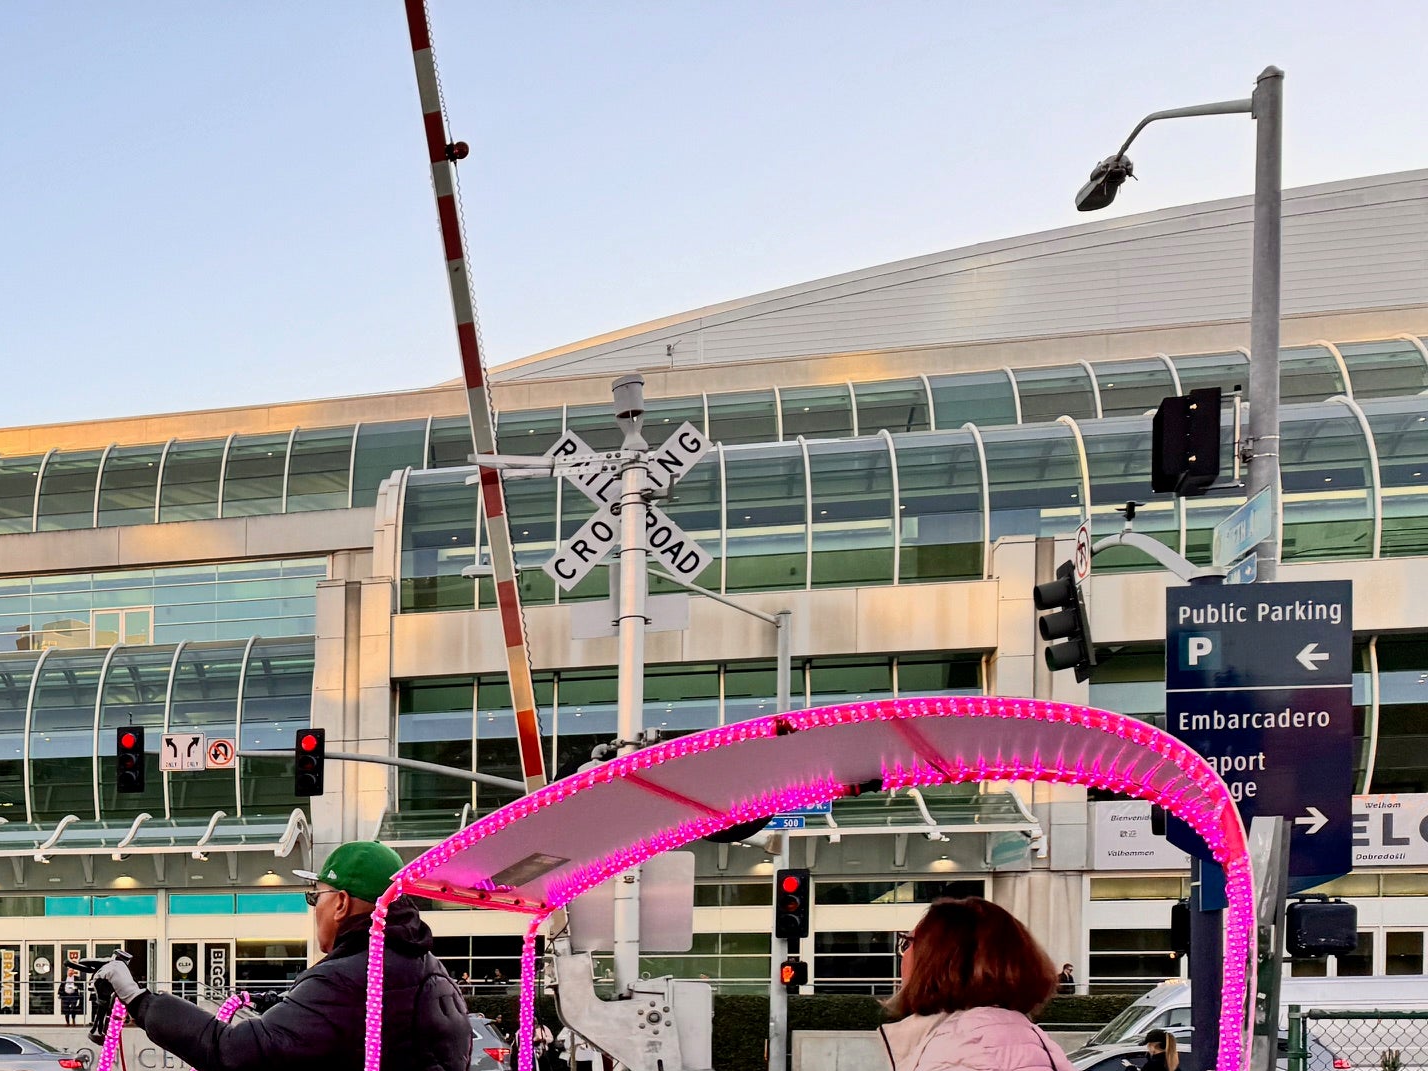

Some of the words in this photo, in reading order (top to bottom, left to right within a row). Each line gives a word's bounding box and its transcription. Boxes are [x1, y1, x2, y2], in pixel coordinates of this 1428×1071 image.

[1178, 602, 1248, 625] Public
[1257, 600, 1343, 625] Parking
[1188, 637, 1213, 666] P
[1178, 707, 1331, 731] Embarcadero
[1208, 751, 1266, 777] aport
[783, 819, 799, 827] 500
[1110, 814, 1152, 822] Bienvenid
[2, 951, 14, 1007] BRAVER
